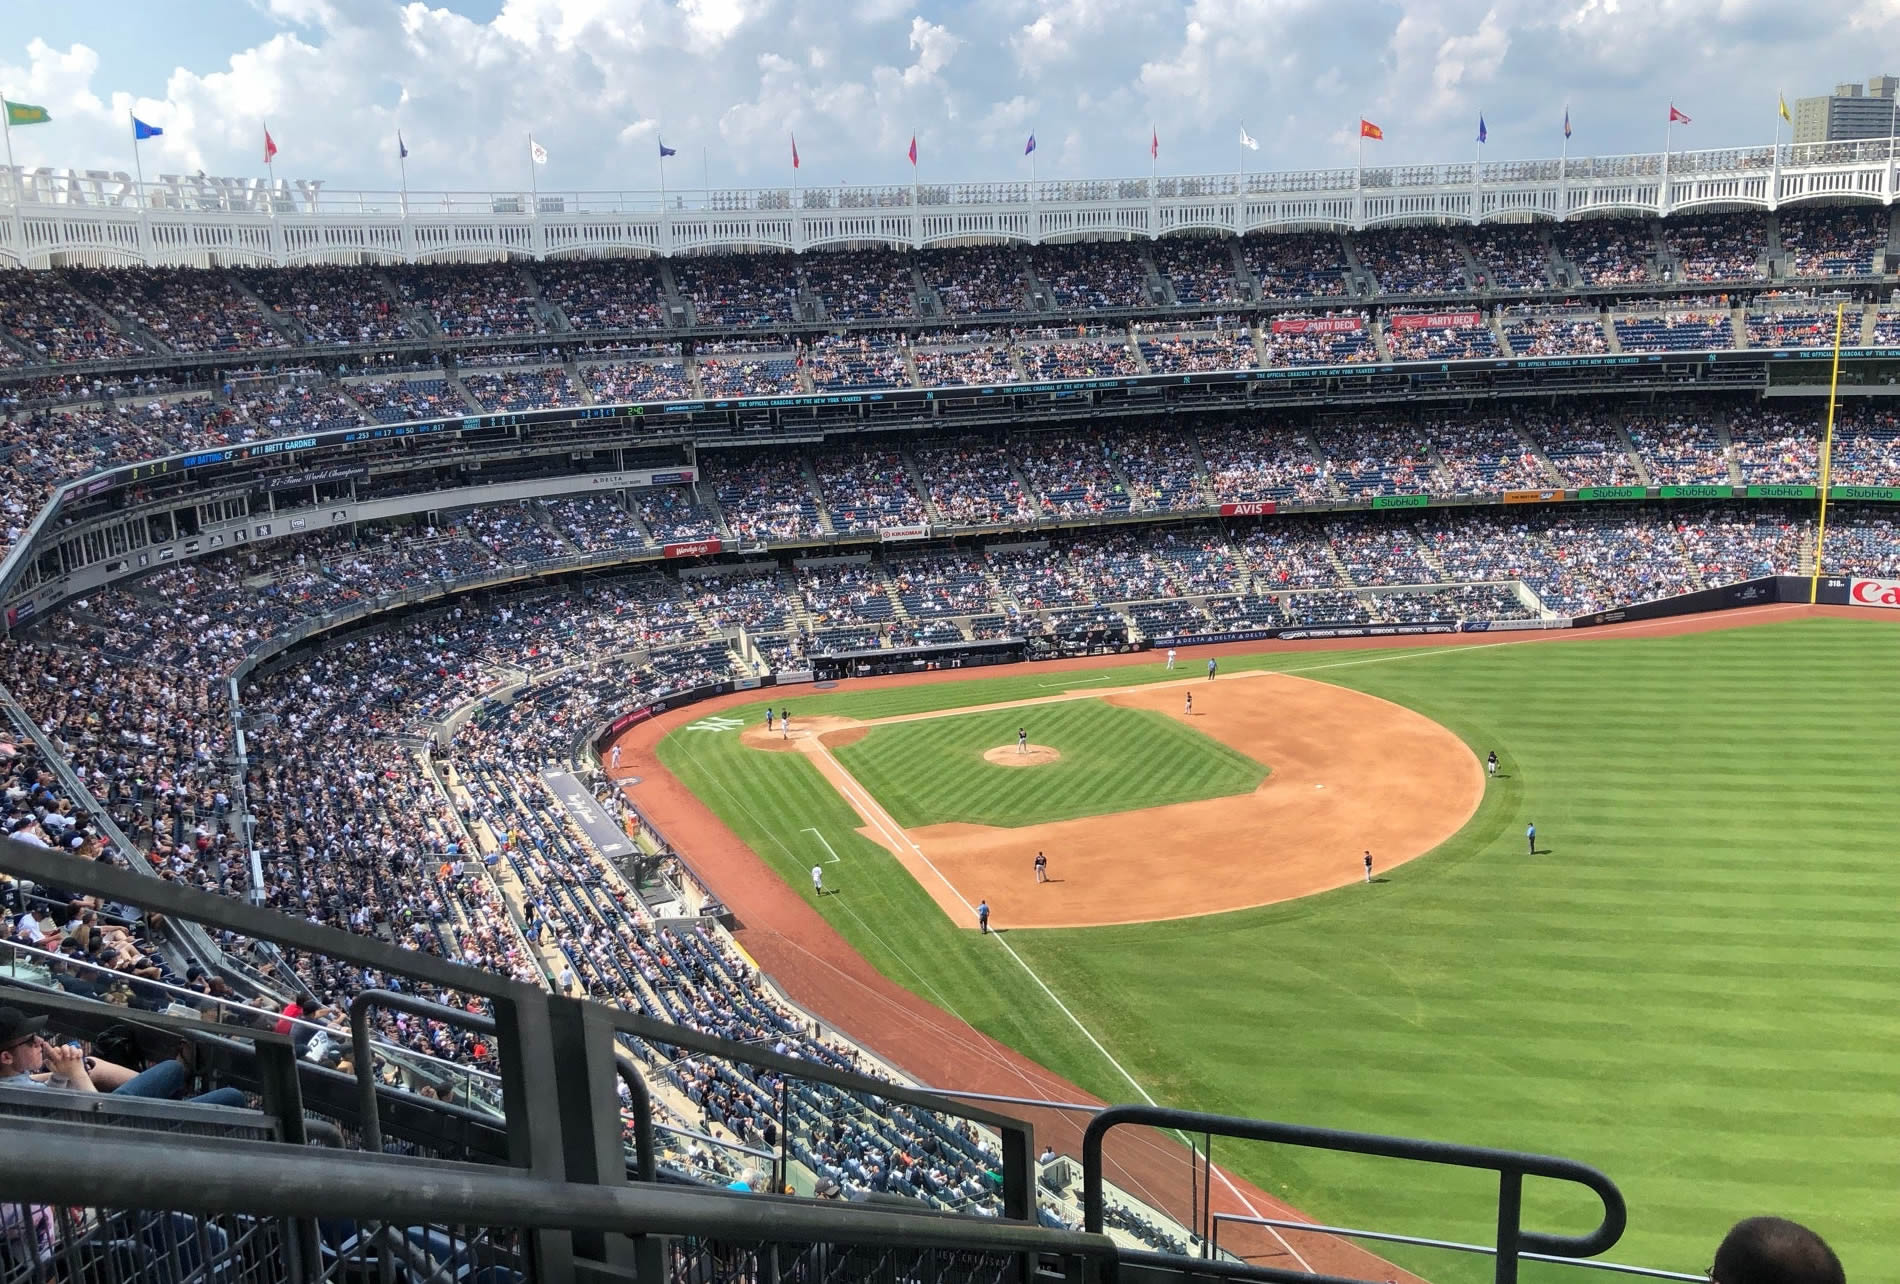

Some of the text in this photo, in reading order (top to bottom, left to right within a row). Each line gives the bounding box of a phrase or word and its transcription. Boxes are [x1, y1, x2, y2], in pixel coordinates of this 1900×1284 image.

[1308, 322, 1332, 330] PARTY
[1334, 320, 1356, 329] DECK
[1428, 316, 1452, 326] PARTY
[1453, 315, 1474, 324] DECK
[224, 451, 233, 459] CF
[252, 447, 263, 456] #11
[265, 443, 283, 453] BRETT
[285, 438, 316, 450] GARDNER
[304, 471, 328, 480] World
[328, 468, 364, 478] Champions
[1592, 489, 1632, 498] StubHub
[1675, 488, 1717, 496] StubHub
[1760, 488, 1803, 496] StubHub
[1846, 488, 1893, 499] StubHub
[1381, 498, 1419, 507] StubHub
[1234, 504, 1263, 514] AVIS
[676, 546, 698, 555] Wendy's
